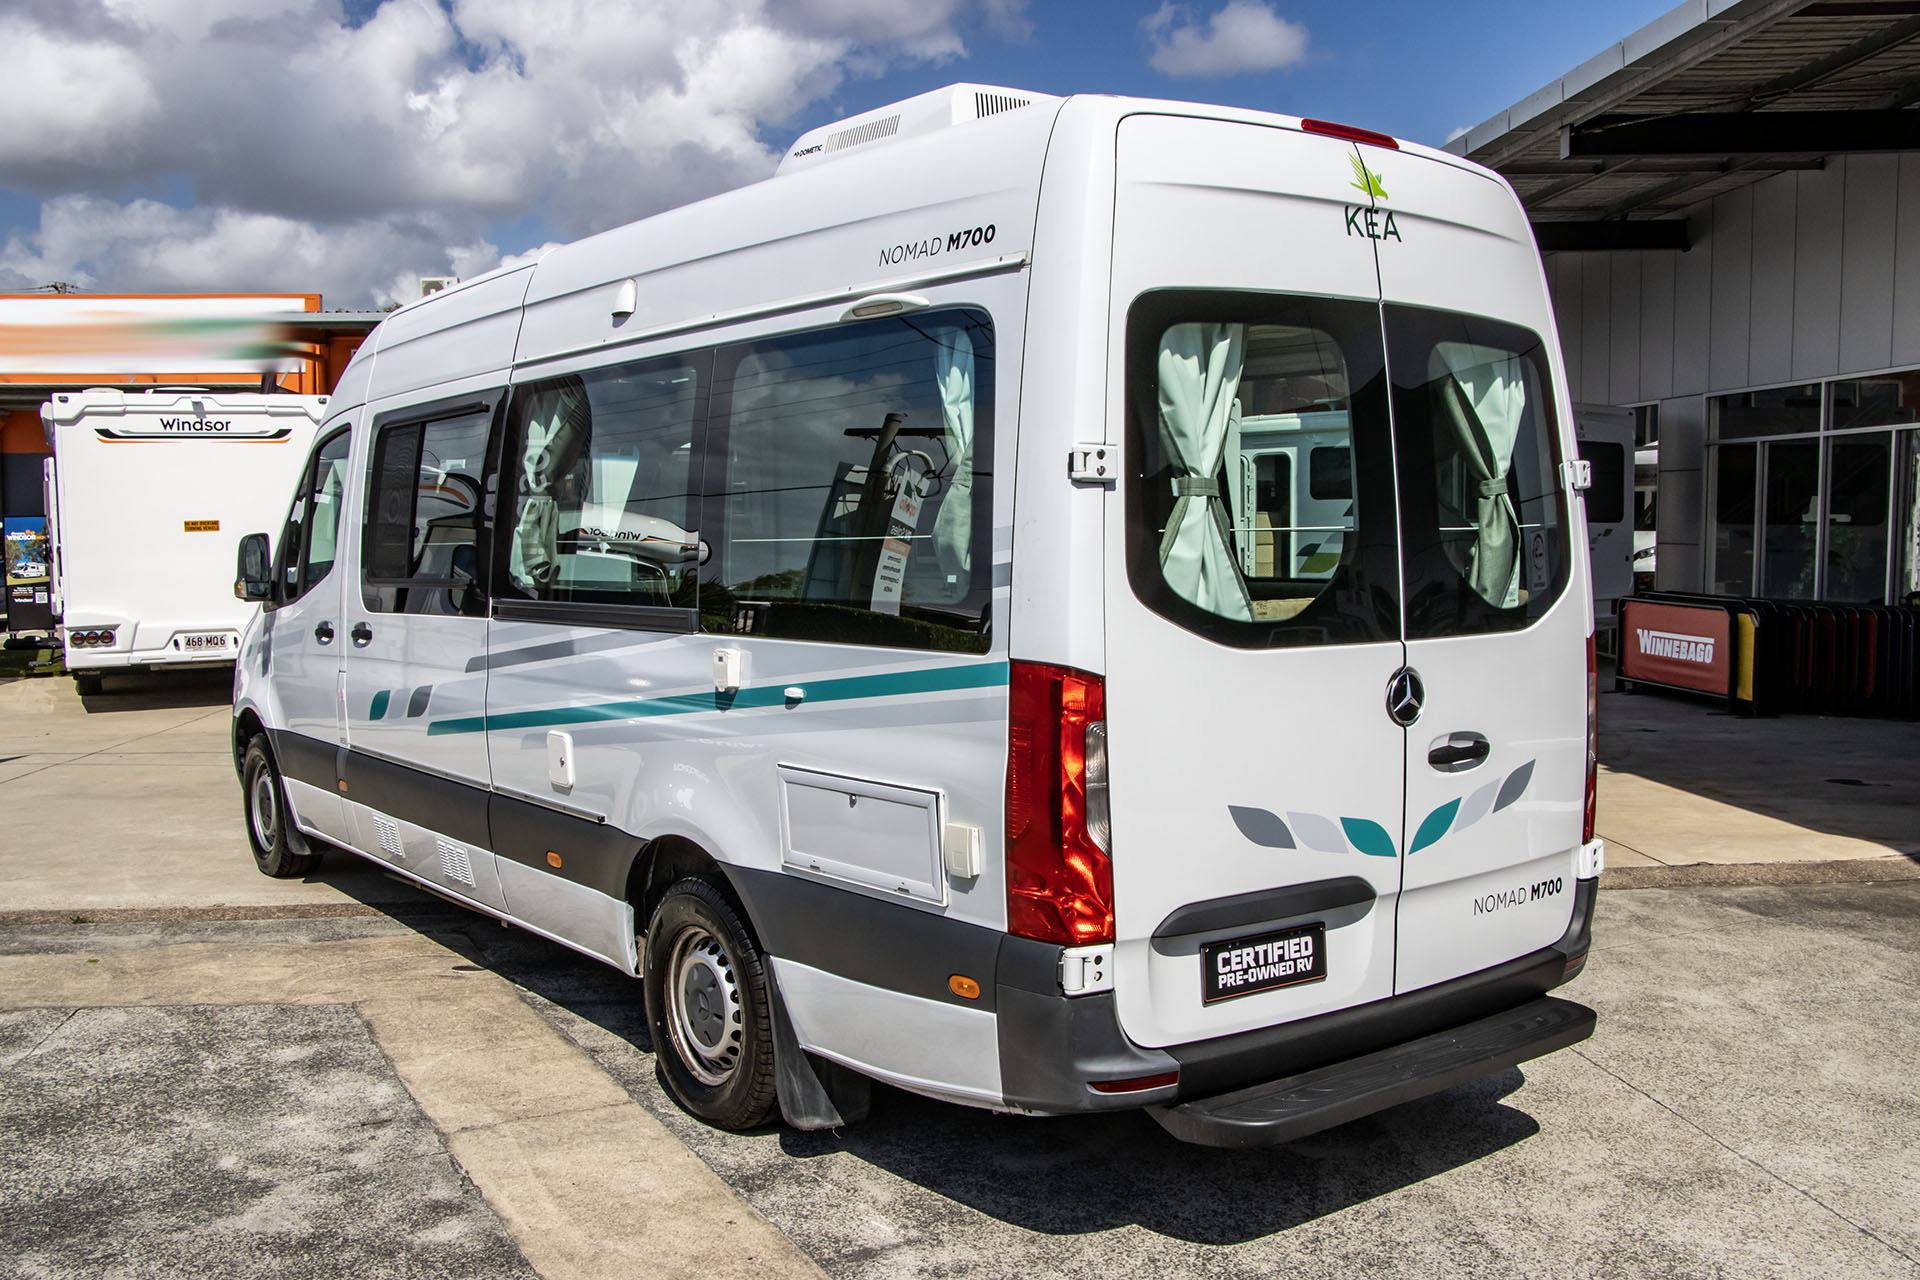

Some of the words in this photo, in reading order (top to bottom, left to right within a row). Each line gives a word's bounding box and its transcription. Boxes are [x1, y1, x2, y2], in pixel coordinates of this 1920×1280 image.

[800, 144, 823, 157] DOMETIC
[1344, 205, 1402, 242] KEA
[878, 237, 942, 267] NOMAD
[946, 224, 996, 252] M700
[160, 417, 232, 432] Windsor
[1636, 627, 1715, 664] WINNEBAGO
[1473, 887, 1527, 916] NOMAD
[1530, 876, 1562, 901] M700
[1217, 935, 1314, 974] CERTIFIED
[1218, 961, 1295, 989] PRE-OWNED
[1296, 956, 1314, 973] RV
